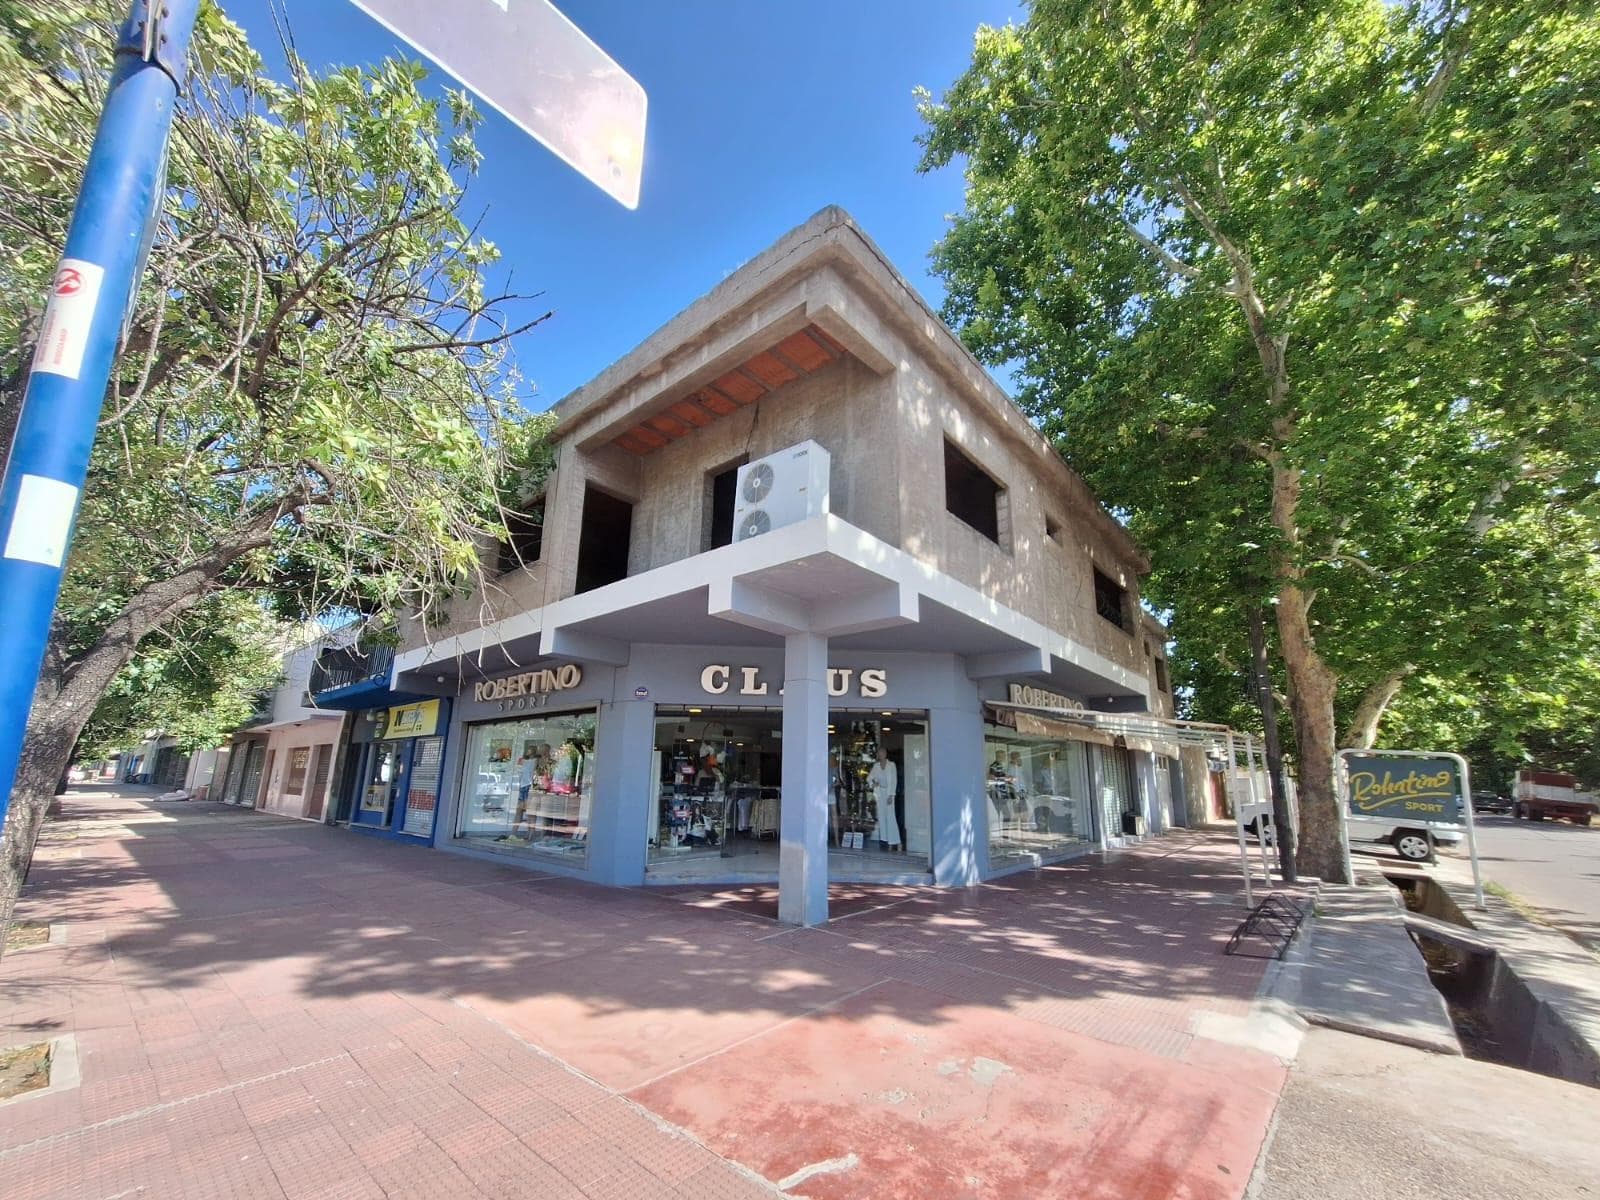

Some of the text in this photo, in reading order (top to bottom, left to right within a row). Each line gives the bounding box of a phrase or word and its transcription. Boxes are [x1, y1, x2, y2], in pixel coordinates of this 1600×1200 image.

[474, 664, 581, 702] ROBERTINO
[701, 665, 887, 697] CLUS
[497, 695, 549, 712] SPORT
[1405, 801, 1444, 812] SPORT
